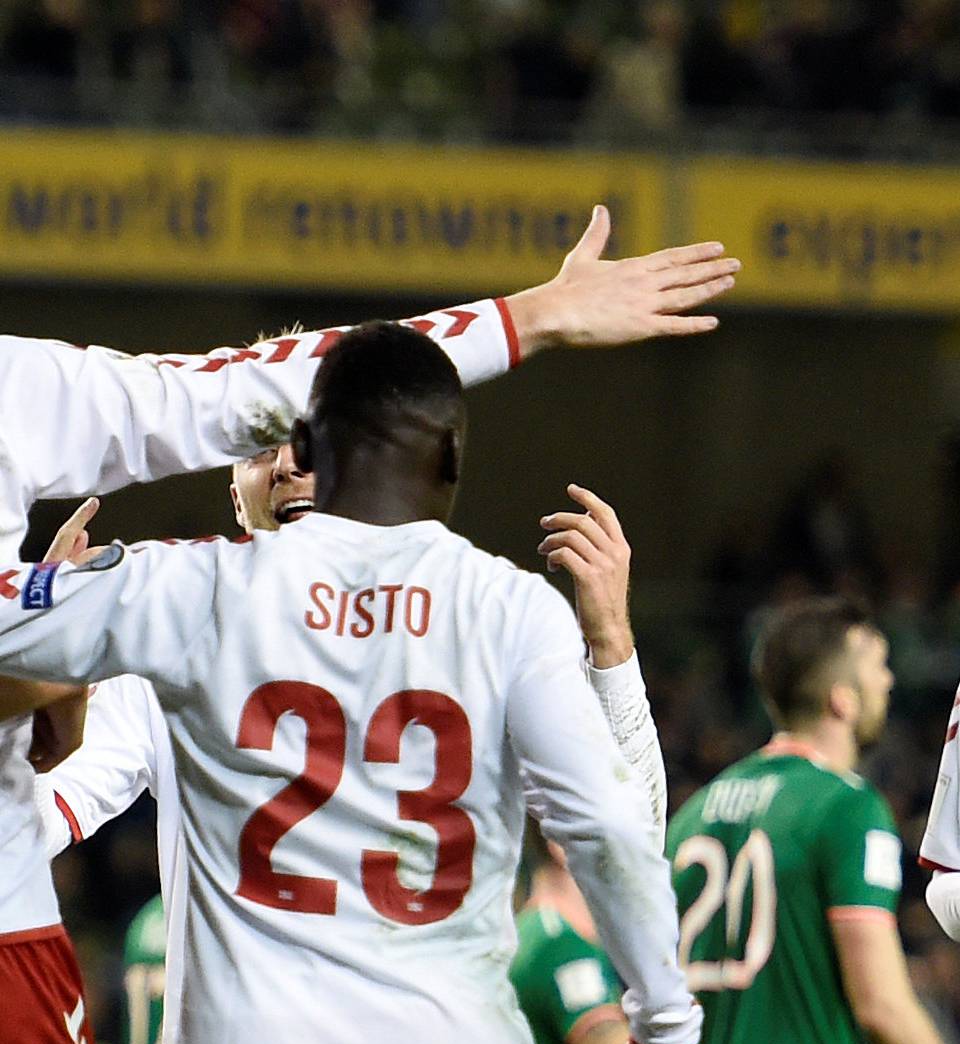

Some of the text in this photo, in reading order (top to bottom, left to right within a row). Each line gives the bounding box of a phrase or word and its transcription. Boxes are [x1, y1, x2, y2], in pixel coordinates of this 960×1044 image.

[304, 582, 432, 638] SISTO
[235, 679, 476, 926] 23
[674, 828, 777, 992] 20
